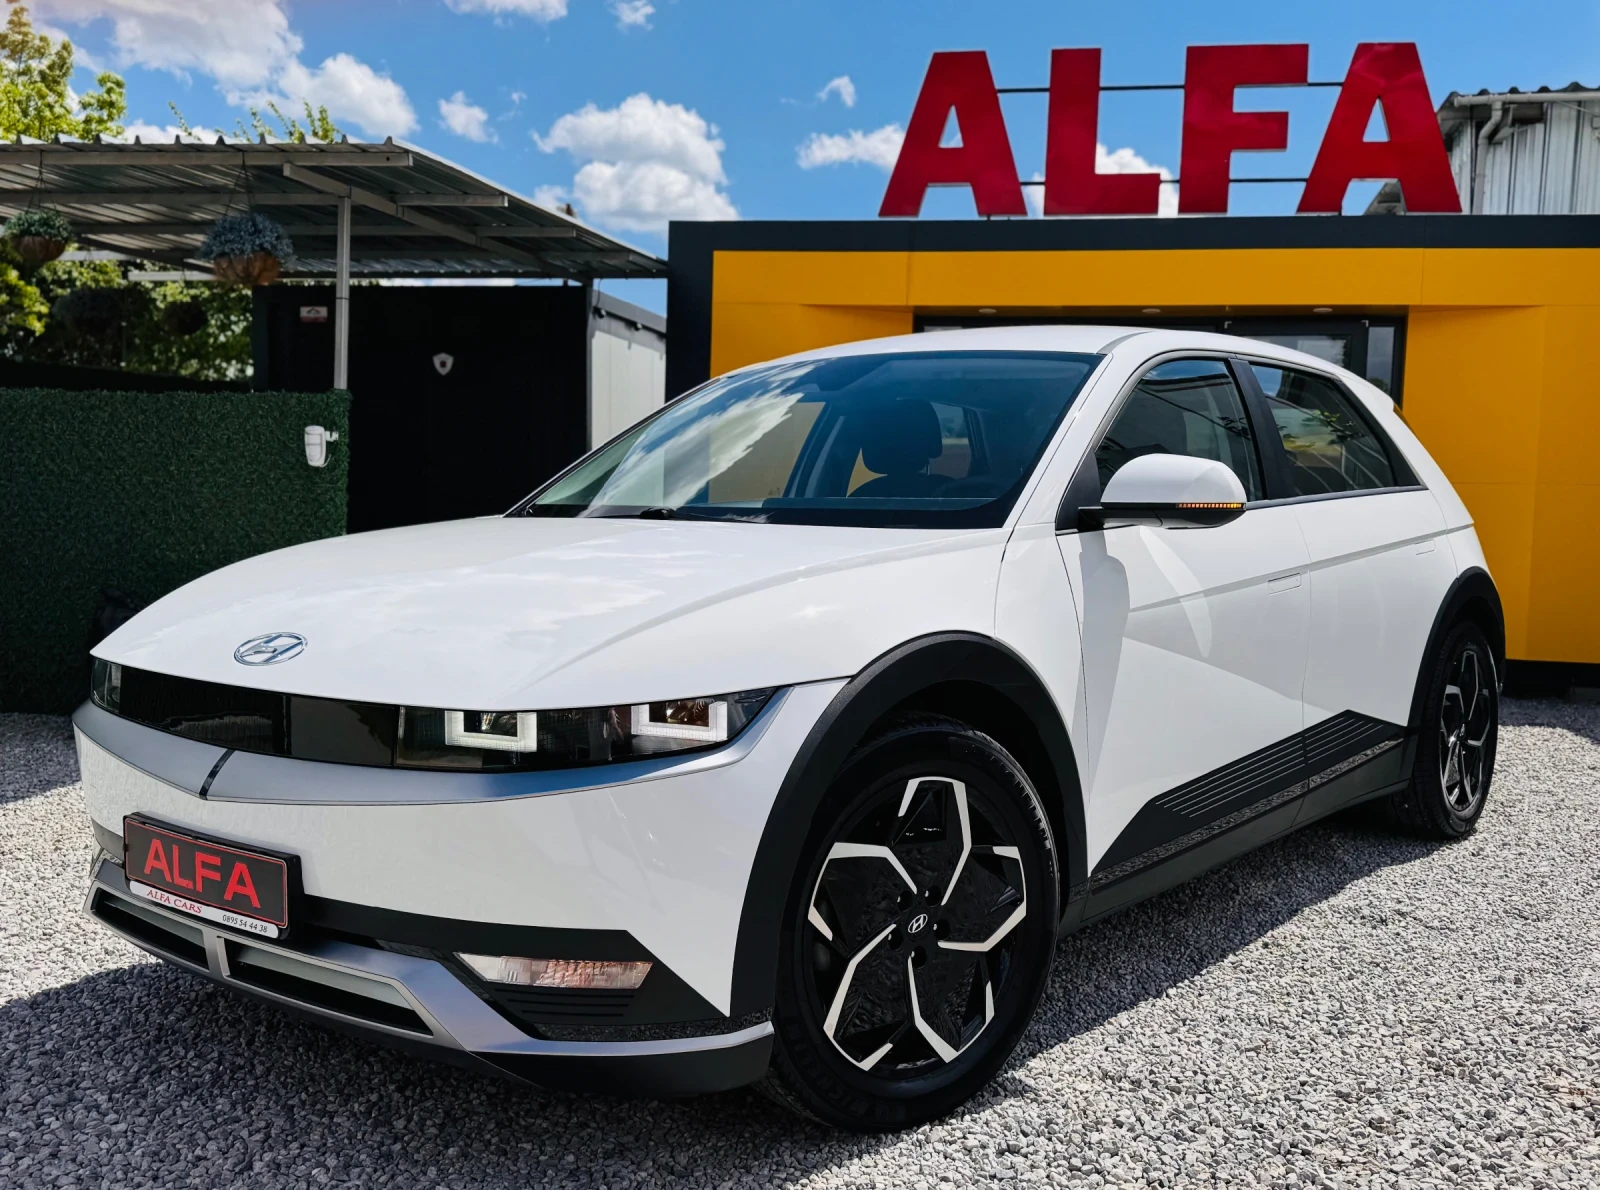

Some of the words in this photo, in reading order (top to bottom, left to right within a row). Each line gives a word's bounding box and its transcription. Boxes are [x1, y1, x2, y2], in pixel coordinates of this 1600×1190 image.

[878, 42, 1463, 216] ALFA
[144, 838, 261, 909] ALFA
[147, 889, 171, 904] ALFA
[173, 899, 203, 914] CARS
[222, 914, 238, 925] 0895
[239, 920, 247, 928] 54
[249, 923, 258, 931] 44
[259, 925, 268, 933] 38
